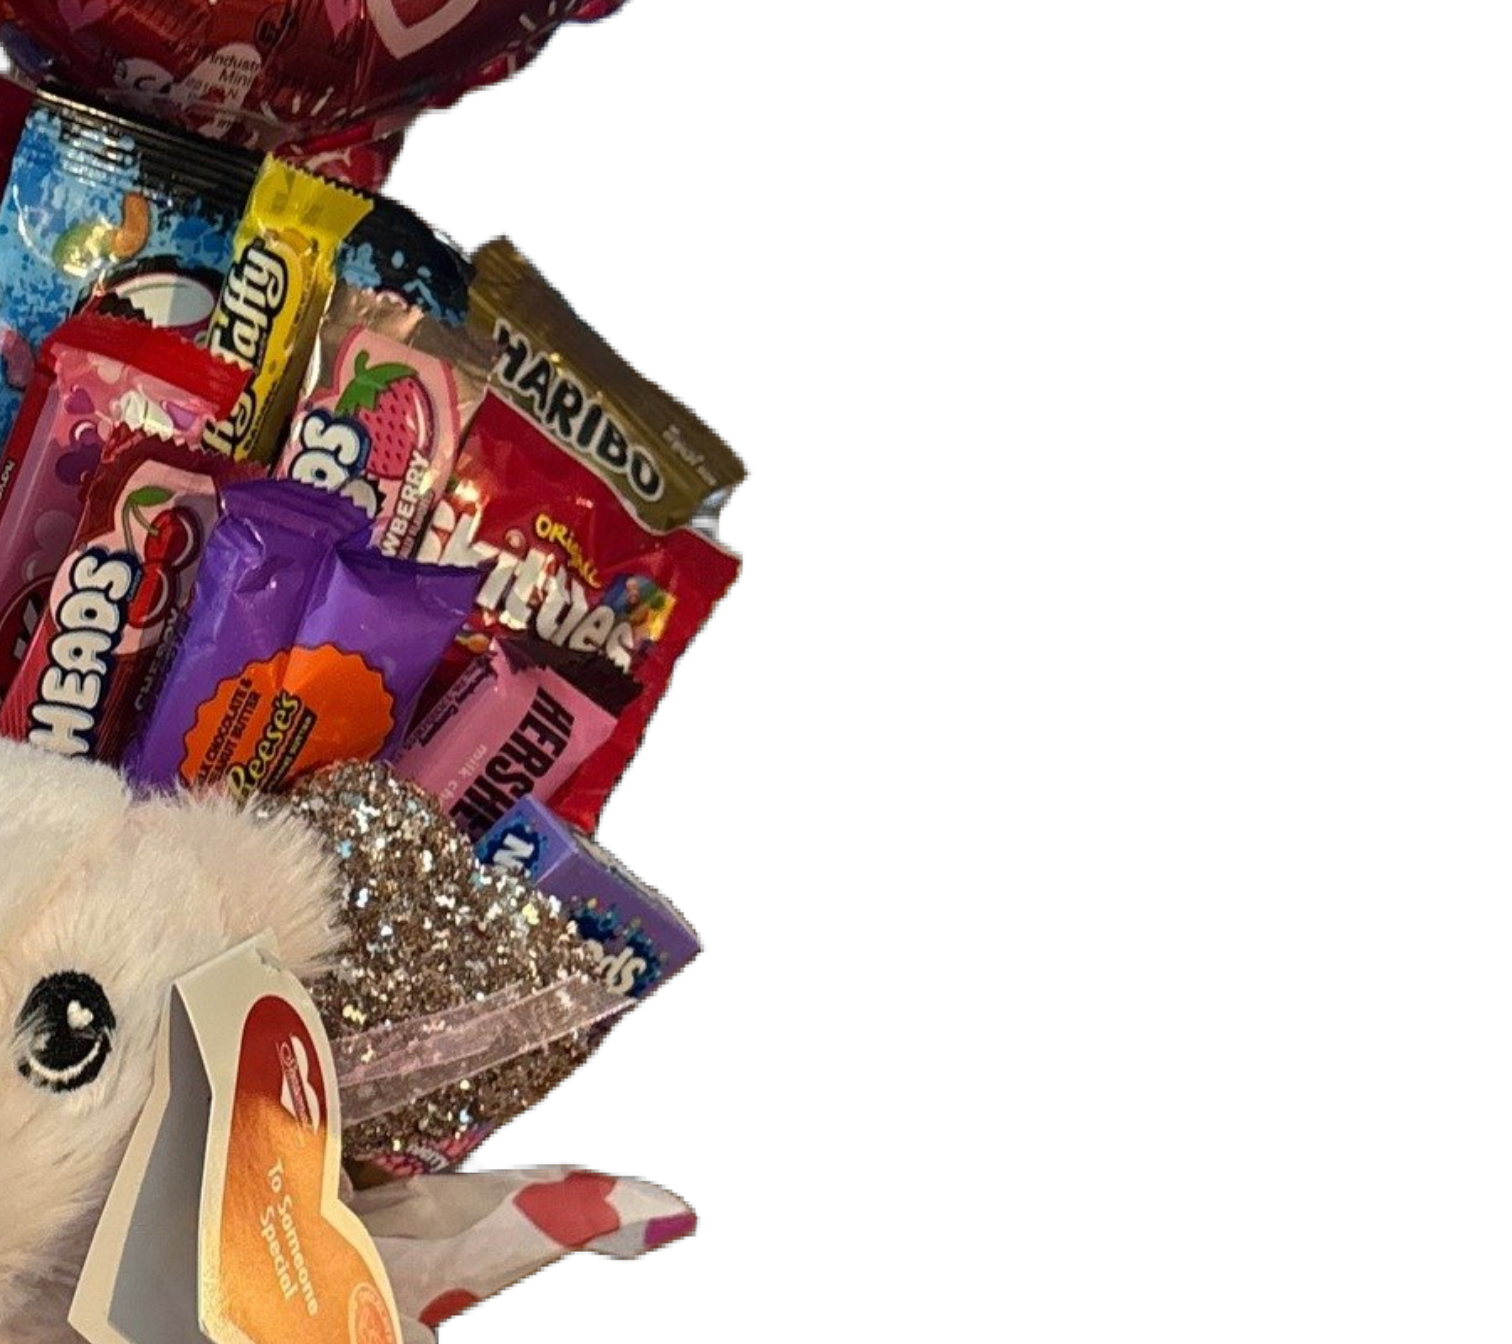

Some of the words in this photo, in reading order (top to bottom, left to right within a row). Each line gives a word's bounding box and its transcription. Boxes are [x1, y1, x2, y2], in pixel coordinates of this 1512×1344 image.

[494, 320, 664, 501] HARIBO
[381, 449, 430, 555] WBERRY
[29, 554, 133, 755] HEADS
[451, 686, 575, 843] HERSHE
[259, 1206, 299, 1301] Special
[267, 1158, 284, 1195] To
[276, 1196, 319, 1316] Someone
